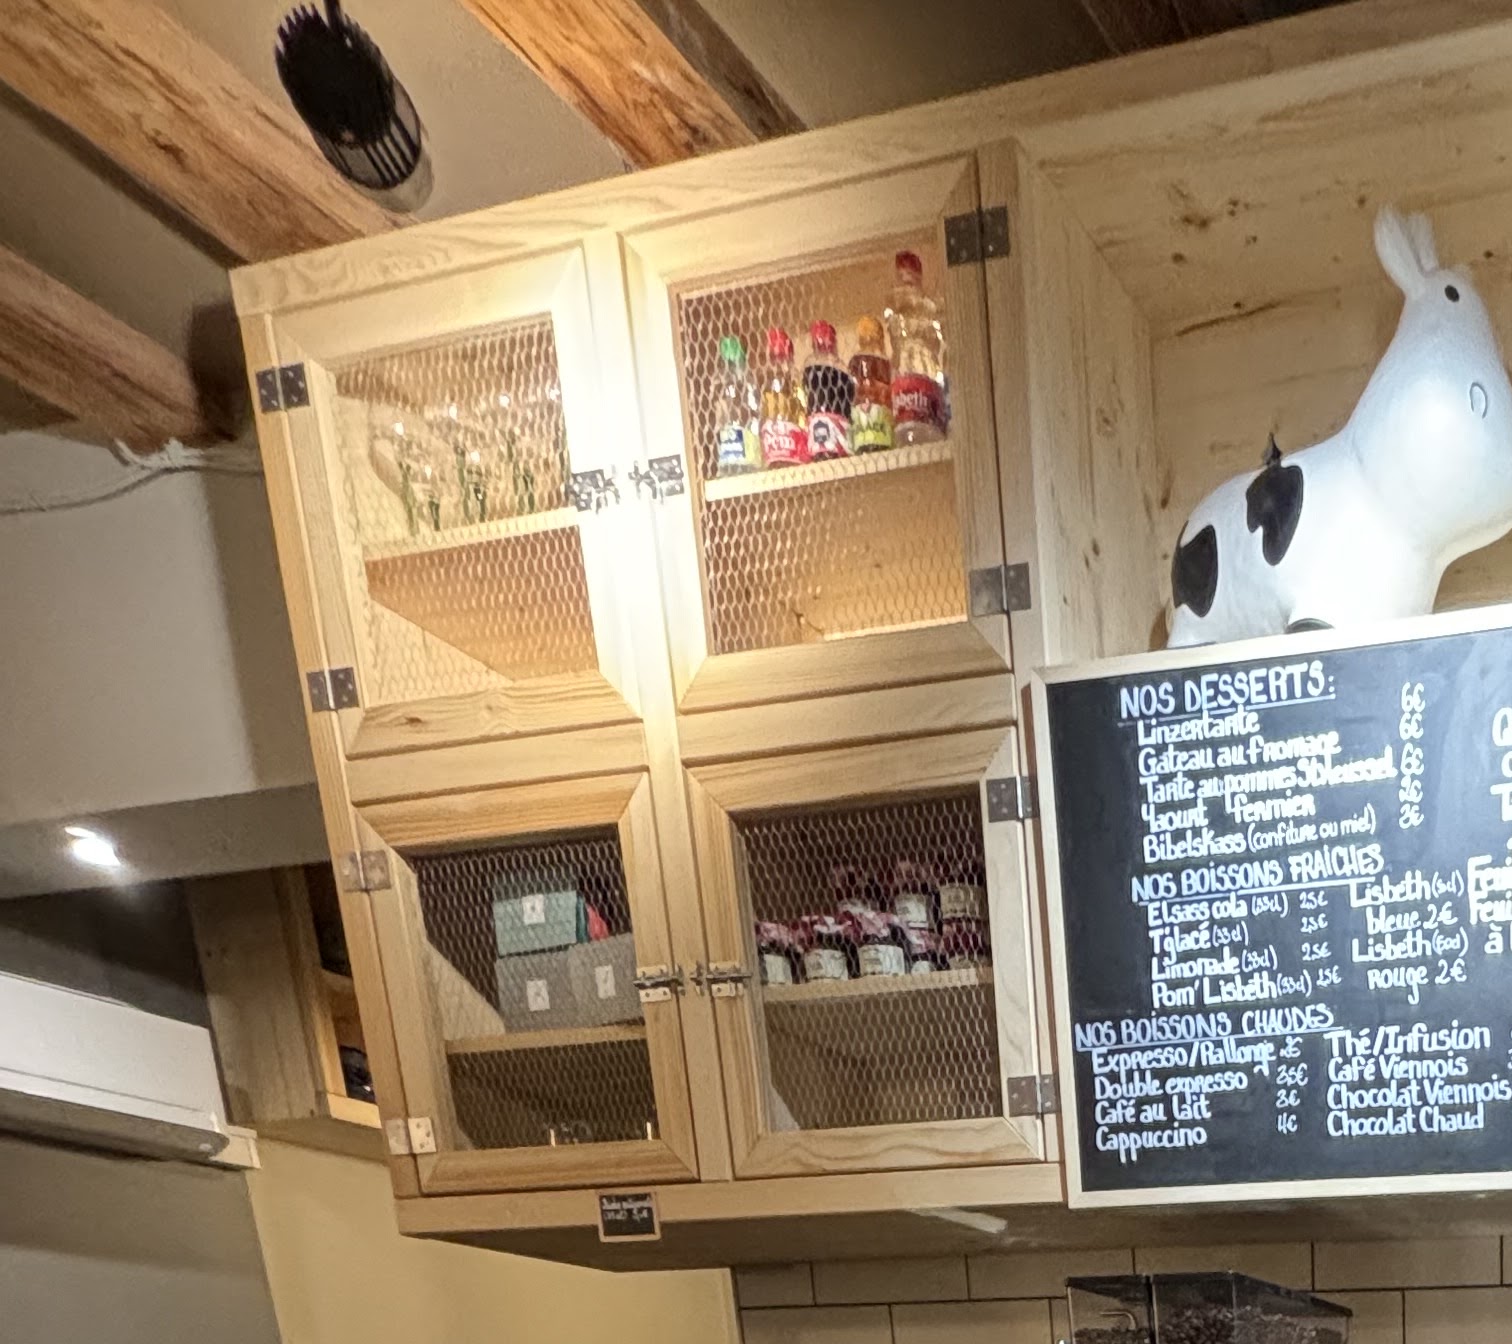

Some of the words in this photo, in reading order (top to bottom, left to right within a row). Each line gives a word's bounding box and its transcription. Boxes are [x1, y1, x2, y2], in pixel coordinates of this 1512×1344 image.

[1120, 683, 1174, 719] NOS
[1218, 746, 1247, 766] au
[1320, 822, 1338, 838] ou
[1131, 873, 1176, 903] NOS
[1350, 870, 1431, 908] Lisbeth
[1148, 903, 1210, 926] Elsass
[1213, 893, 1248, 917] cola
[1366, 905, 1422, 935] bleue
[1423, 902, 1458, 929] 2€
[1352, 929, 1431, 962] Lisbeth
[1485, 924, 1503, 954] à
[1435, 958, 1466, 984] 2€
[1075, 1021, 1117, 1049] NOS
[1242, 1003, 1334, 1035] CHAUDES
[1328, 1057, 1375, 1082] Café
[1379, 1051, 1468, 1080] Viennois
[1095, 1073, 1163, 1100] Double
[1166, 1071, 1247, 1102] expresso
[1327, 1080, 1422, 1109] Chocolat
[1423, 1074, 1512, 1104] Viennois
[1095, 1103, 1135, 1125] Café
[1140, 1105, 1167, 1121] au
[1173, 1095, 1211, 1120] lait
[1327, 1108, 1416, 1136] Chocolat
[1420, 1102, 1483, 1132] Chaud
[1096, 1122, 1206, 1163] Cappuccino
